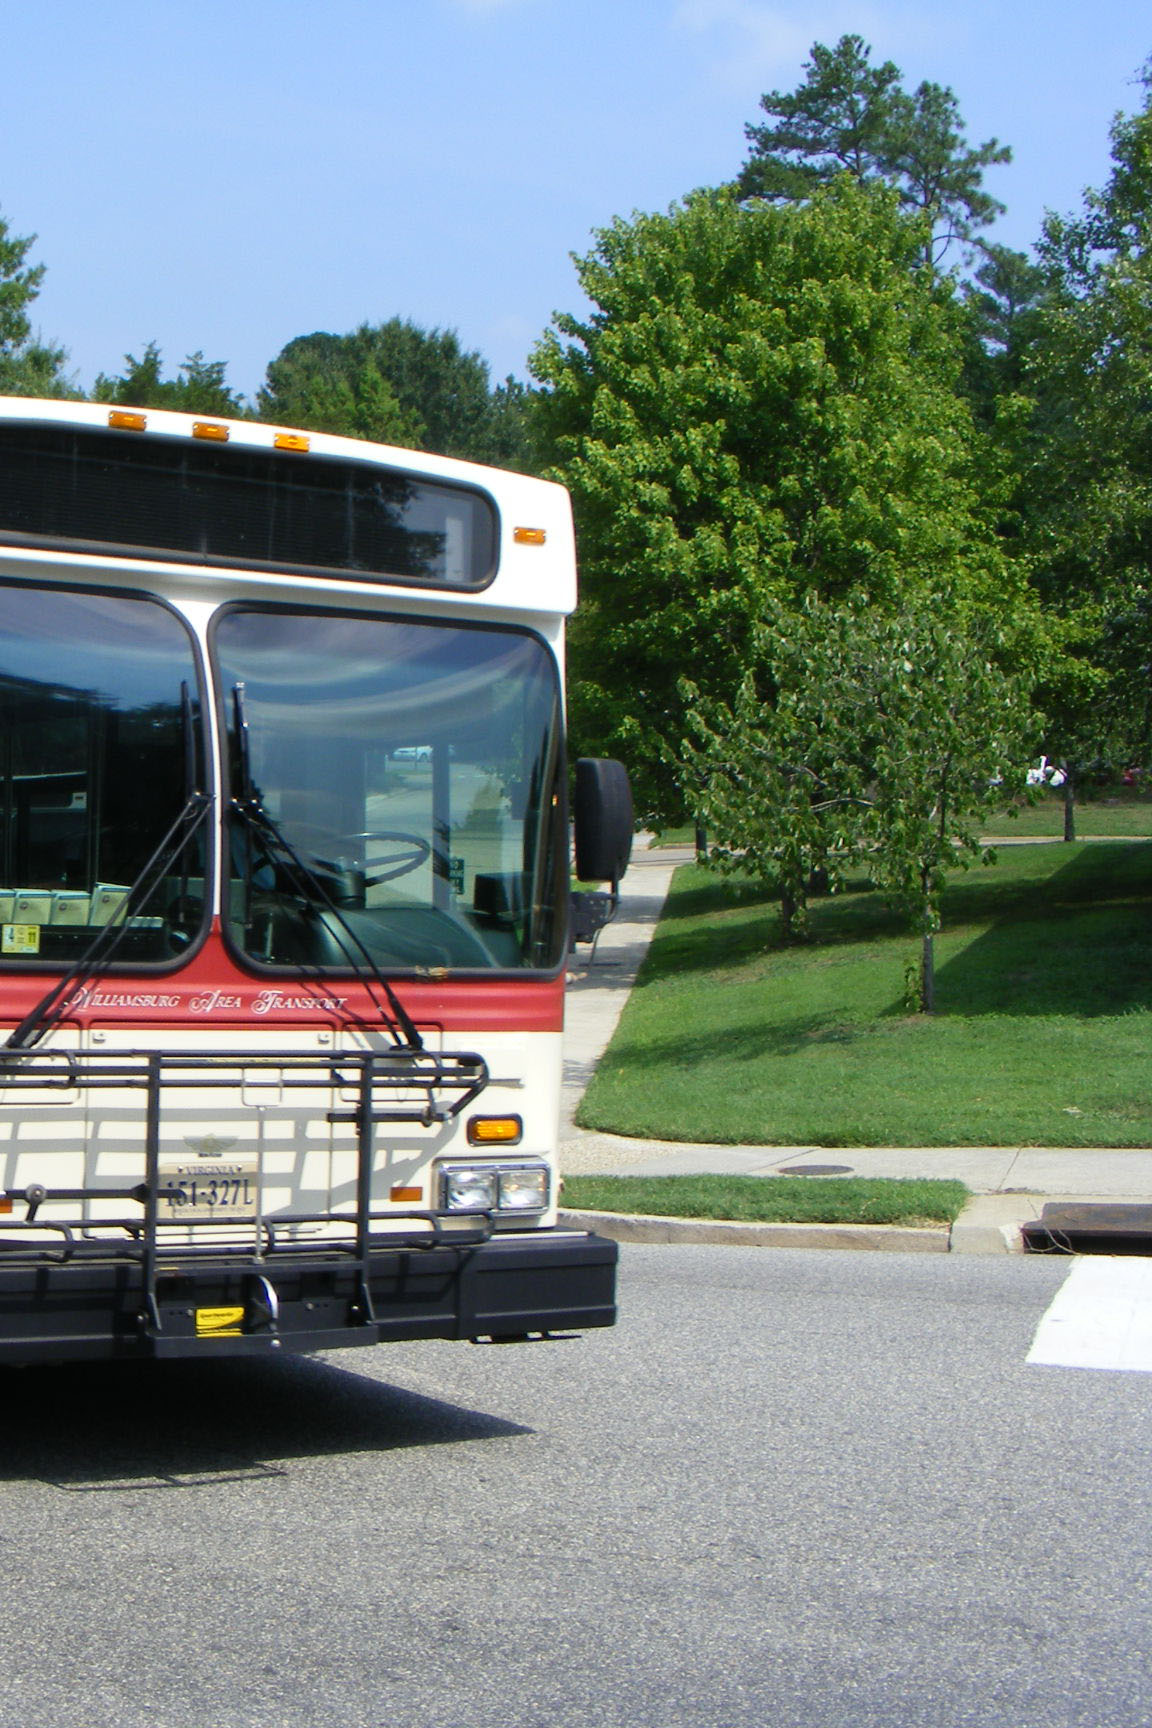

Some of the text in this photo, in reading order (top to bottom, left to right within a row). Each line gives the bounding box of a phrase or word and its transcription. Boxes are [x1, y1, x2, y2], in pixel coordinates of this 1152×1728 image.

[70, 987, 348, 1014] WILLIAMSBURG AREA TRANSPORT
[185, 1166, 236, 1176] VIRGINIA
